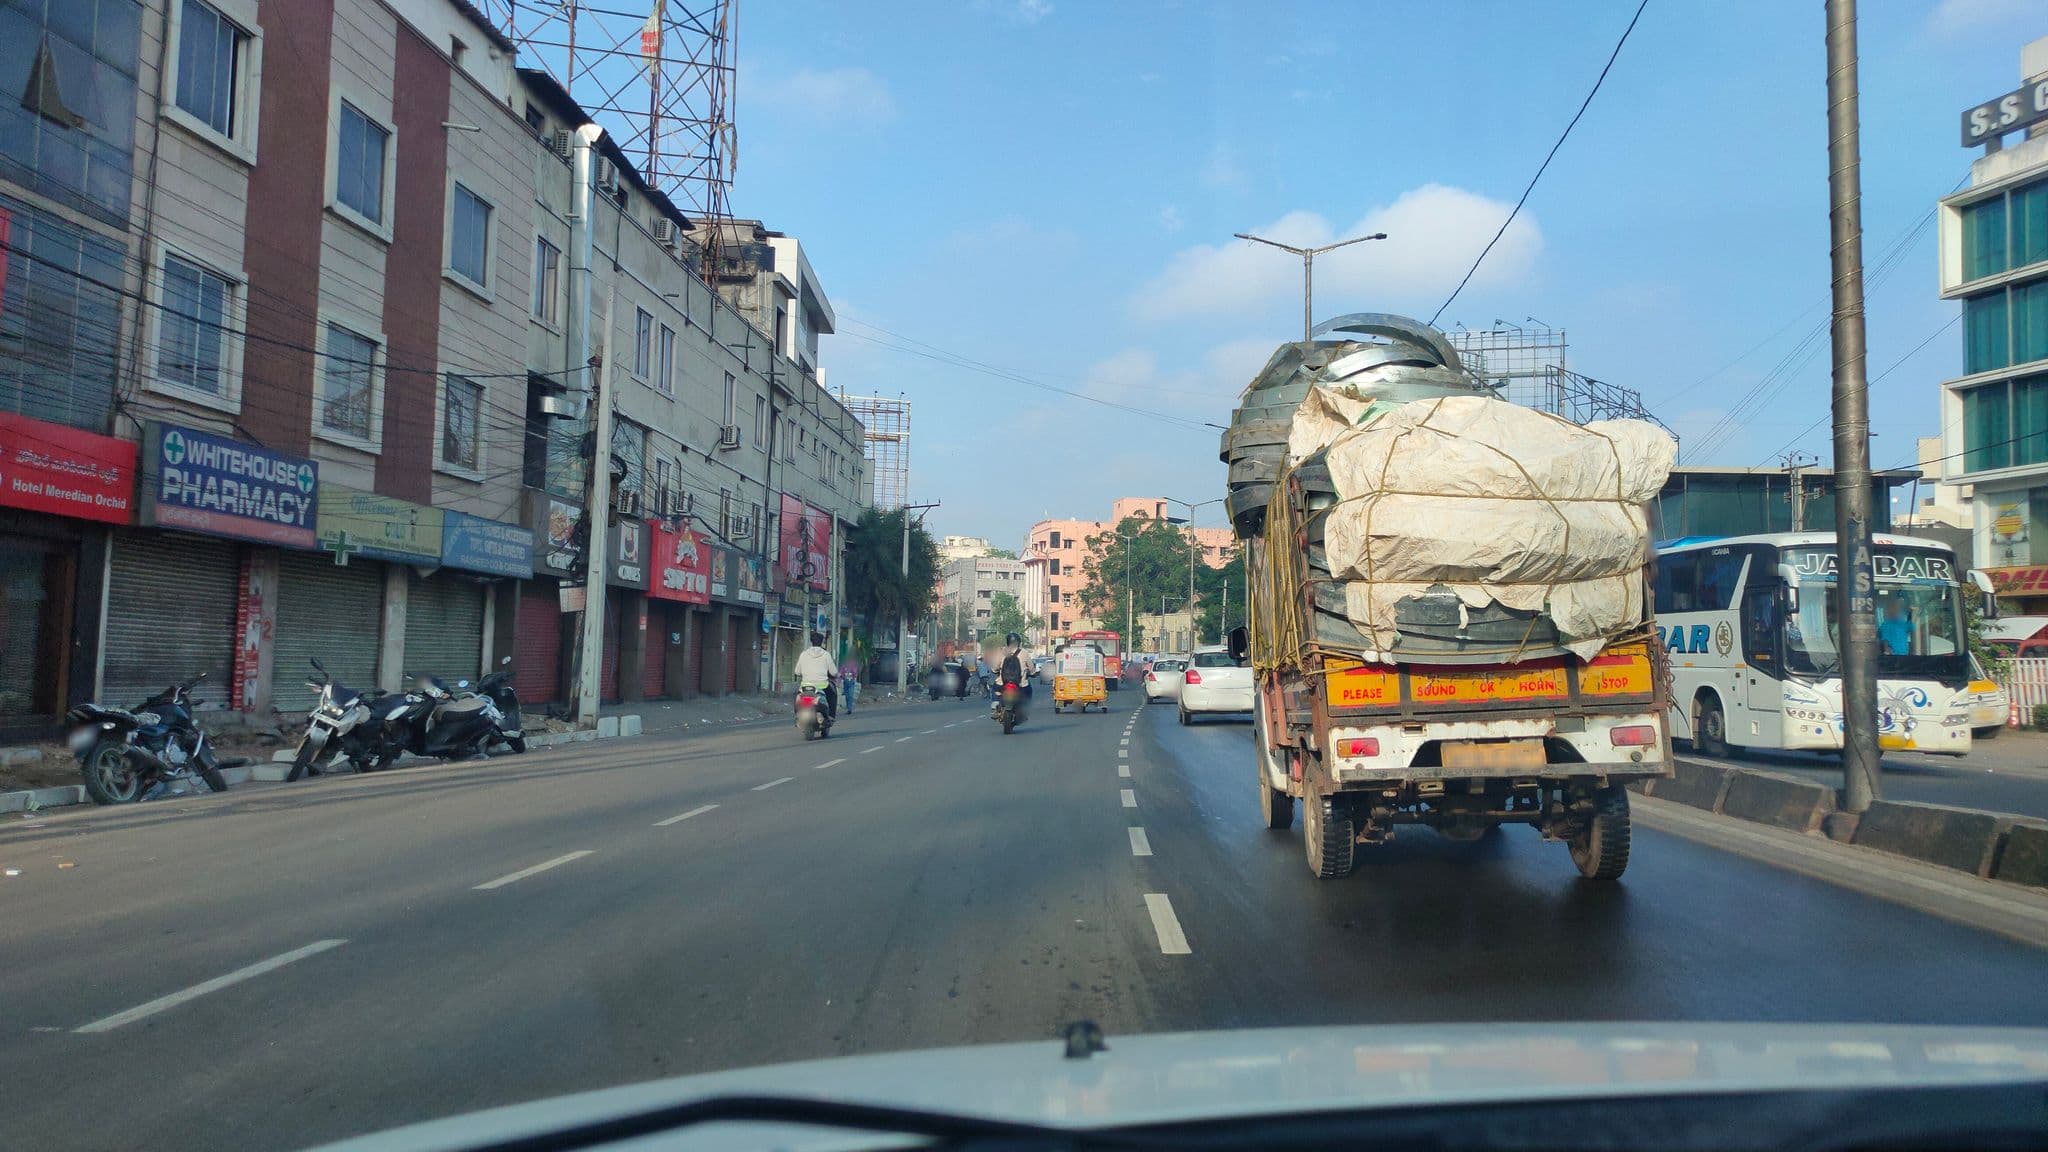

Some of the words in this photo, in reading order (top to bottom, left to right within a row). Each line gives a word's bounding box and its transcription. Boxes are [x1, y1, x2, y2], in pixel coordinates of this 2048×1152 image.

[187, 439, 297, 487] WHITEHOUSE
[13, 479, 43, 496] Hotel
[45, 485, 93, 504] Meredian
[95, 494, 127, 510] Orchid
[163, 467, 311, 526] PHARMACY
[1796, 552, 1953, 581] JABAR
[1343, 688, 1383, 700] PLEASE
[1416, 684, 1457, 697] SOUND
[1519, 681, 1555, 692] HORN
[1601, 677, 1629, 689] STOP
